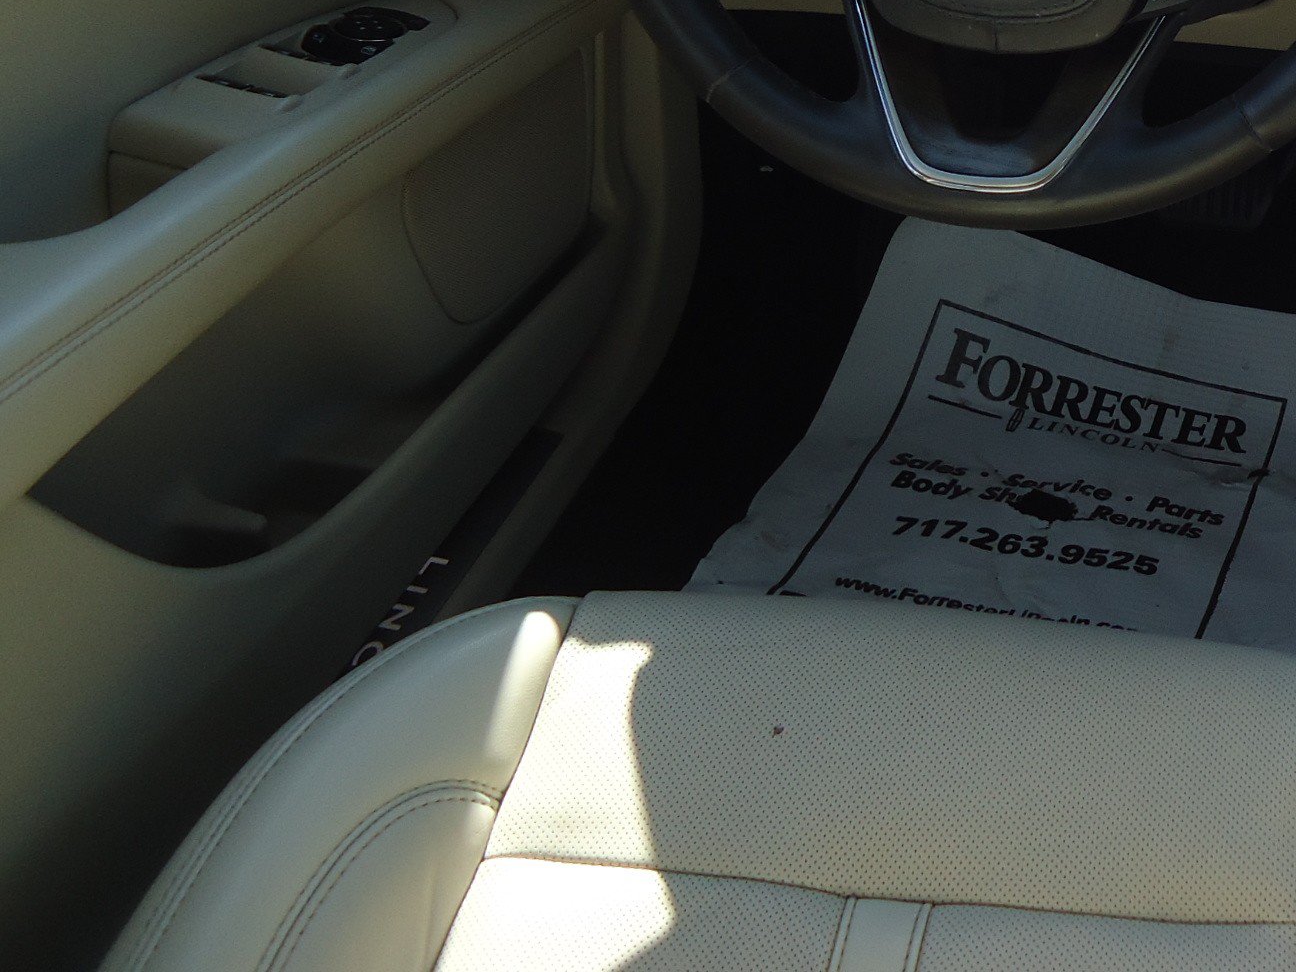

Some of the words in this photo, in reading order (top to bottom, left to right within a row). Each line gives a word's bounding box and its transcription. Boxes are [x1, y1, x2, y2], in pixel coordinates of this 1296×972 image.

[935, 328, 1247, 454] FORRESTER
[1027, 416, 1159, 454] LINCOLN
[889, 452, 967, 477] Sales
[1002, 473, 1113, 501] Service
[1146, 495, 1226, 526] Parts
[890, 470, 973, 500] Body
[1089, 504, 1204, 539] Rentals
[892, 516, 1160, 576] 717.263.9525
